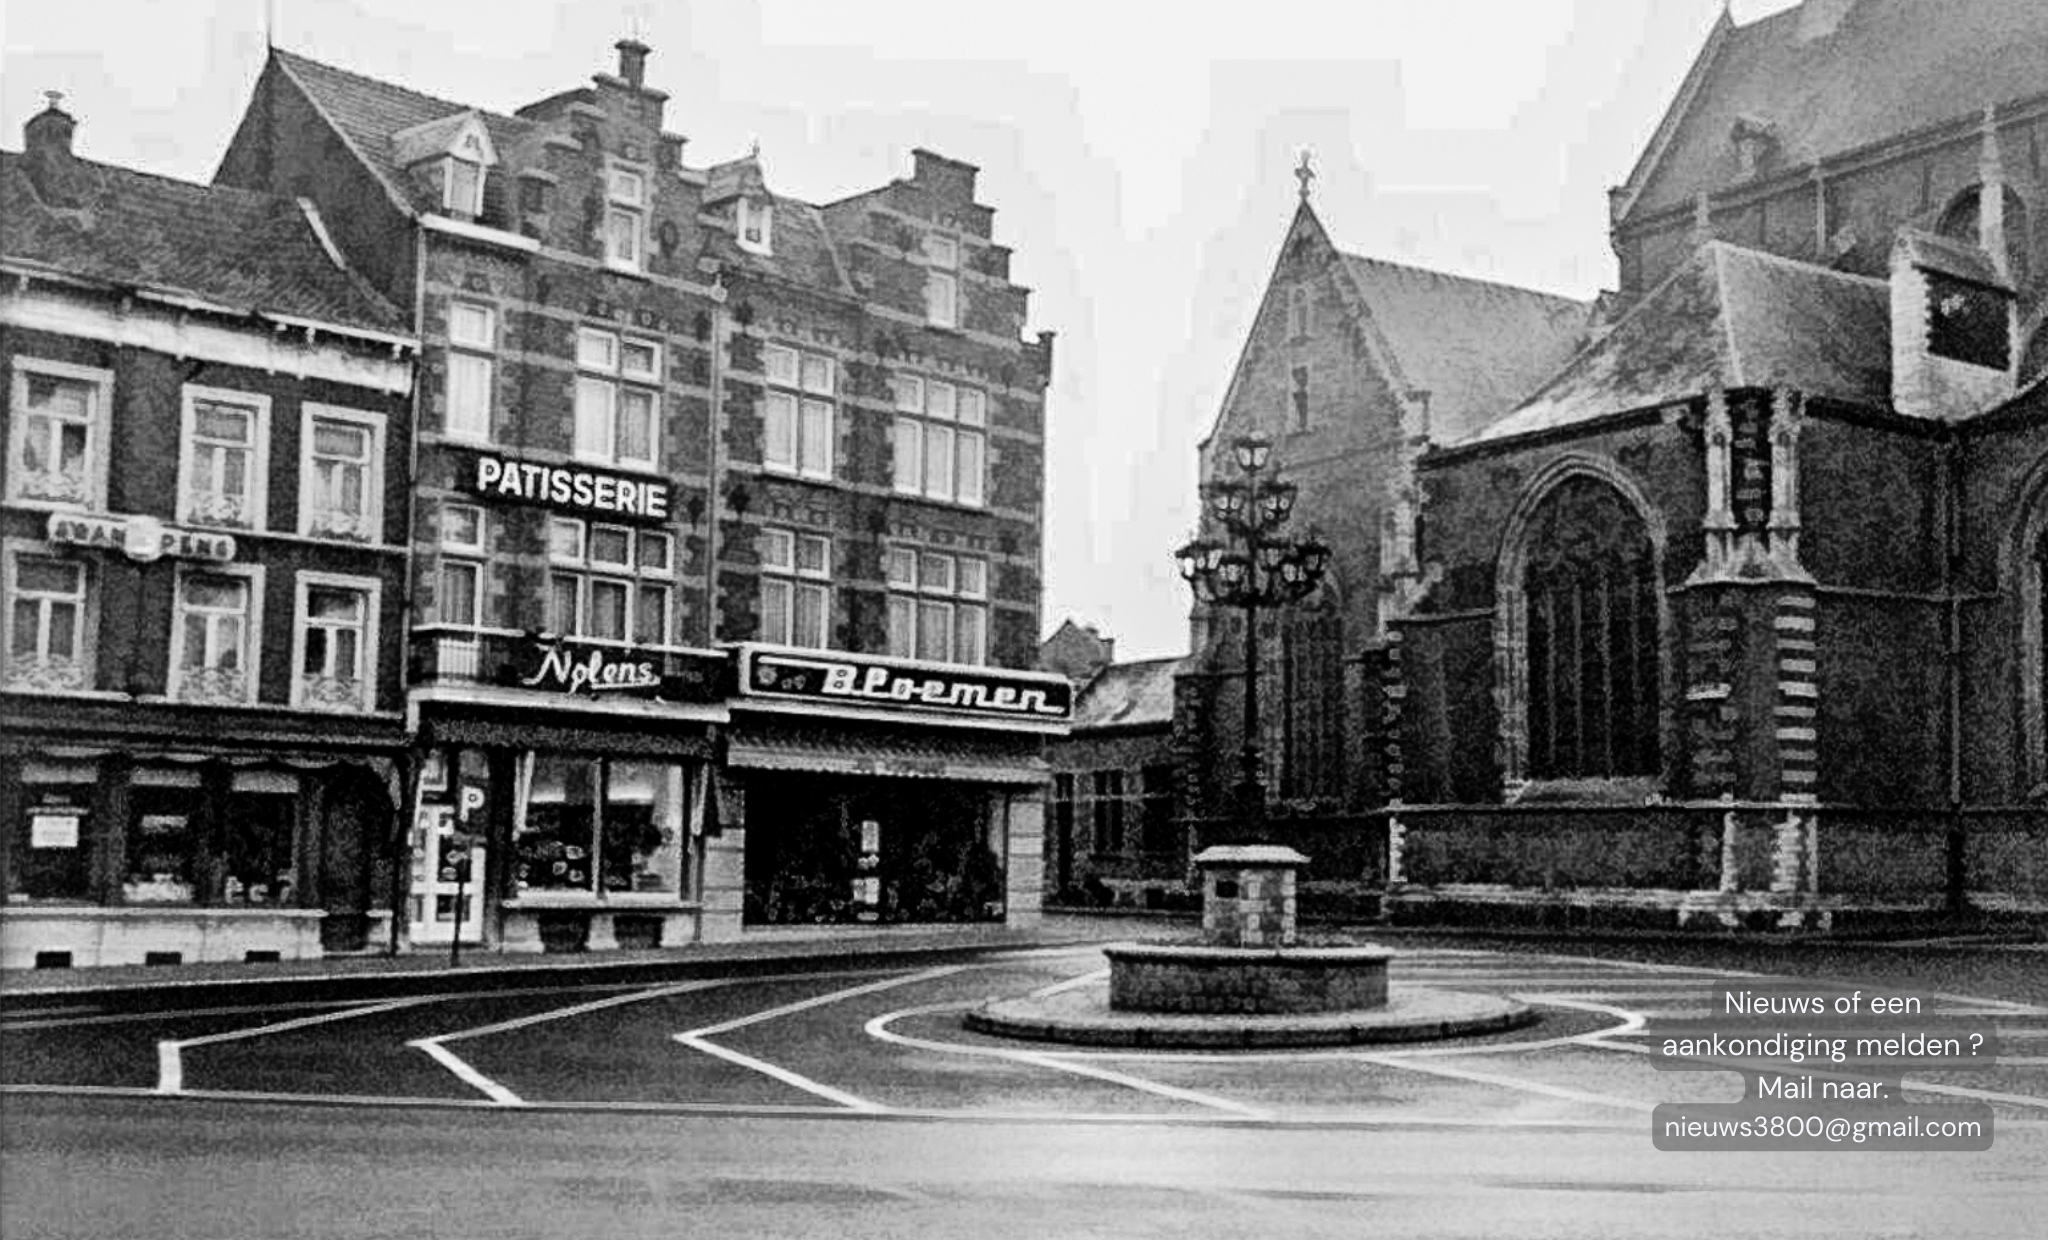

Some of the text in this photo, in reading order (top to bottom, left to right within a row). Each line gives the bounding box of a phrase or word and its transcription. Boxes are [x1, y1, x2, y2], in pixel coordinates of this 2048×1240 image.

[476, 456, 668, 518] PATISSERIE
[521, 643, 661, 695] Nolens
[821, 665, 1066, 715] Bloemen
[460, 786, 485, 823] P
